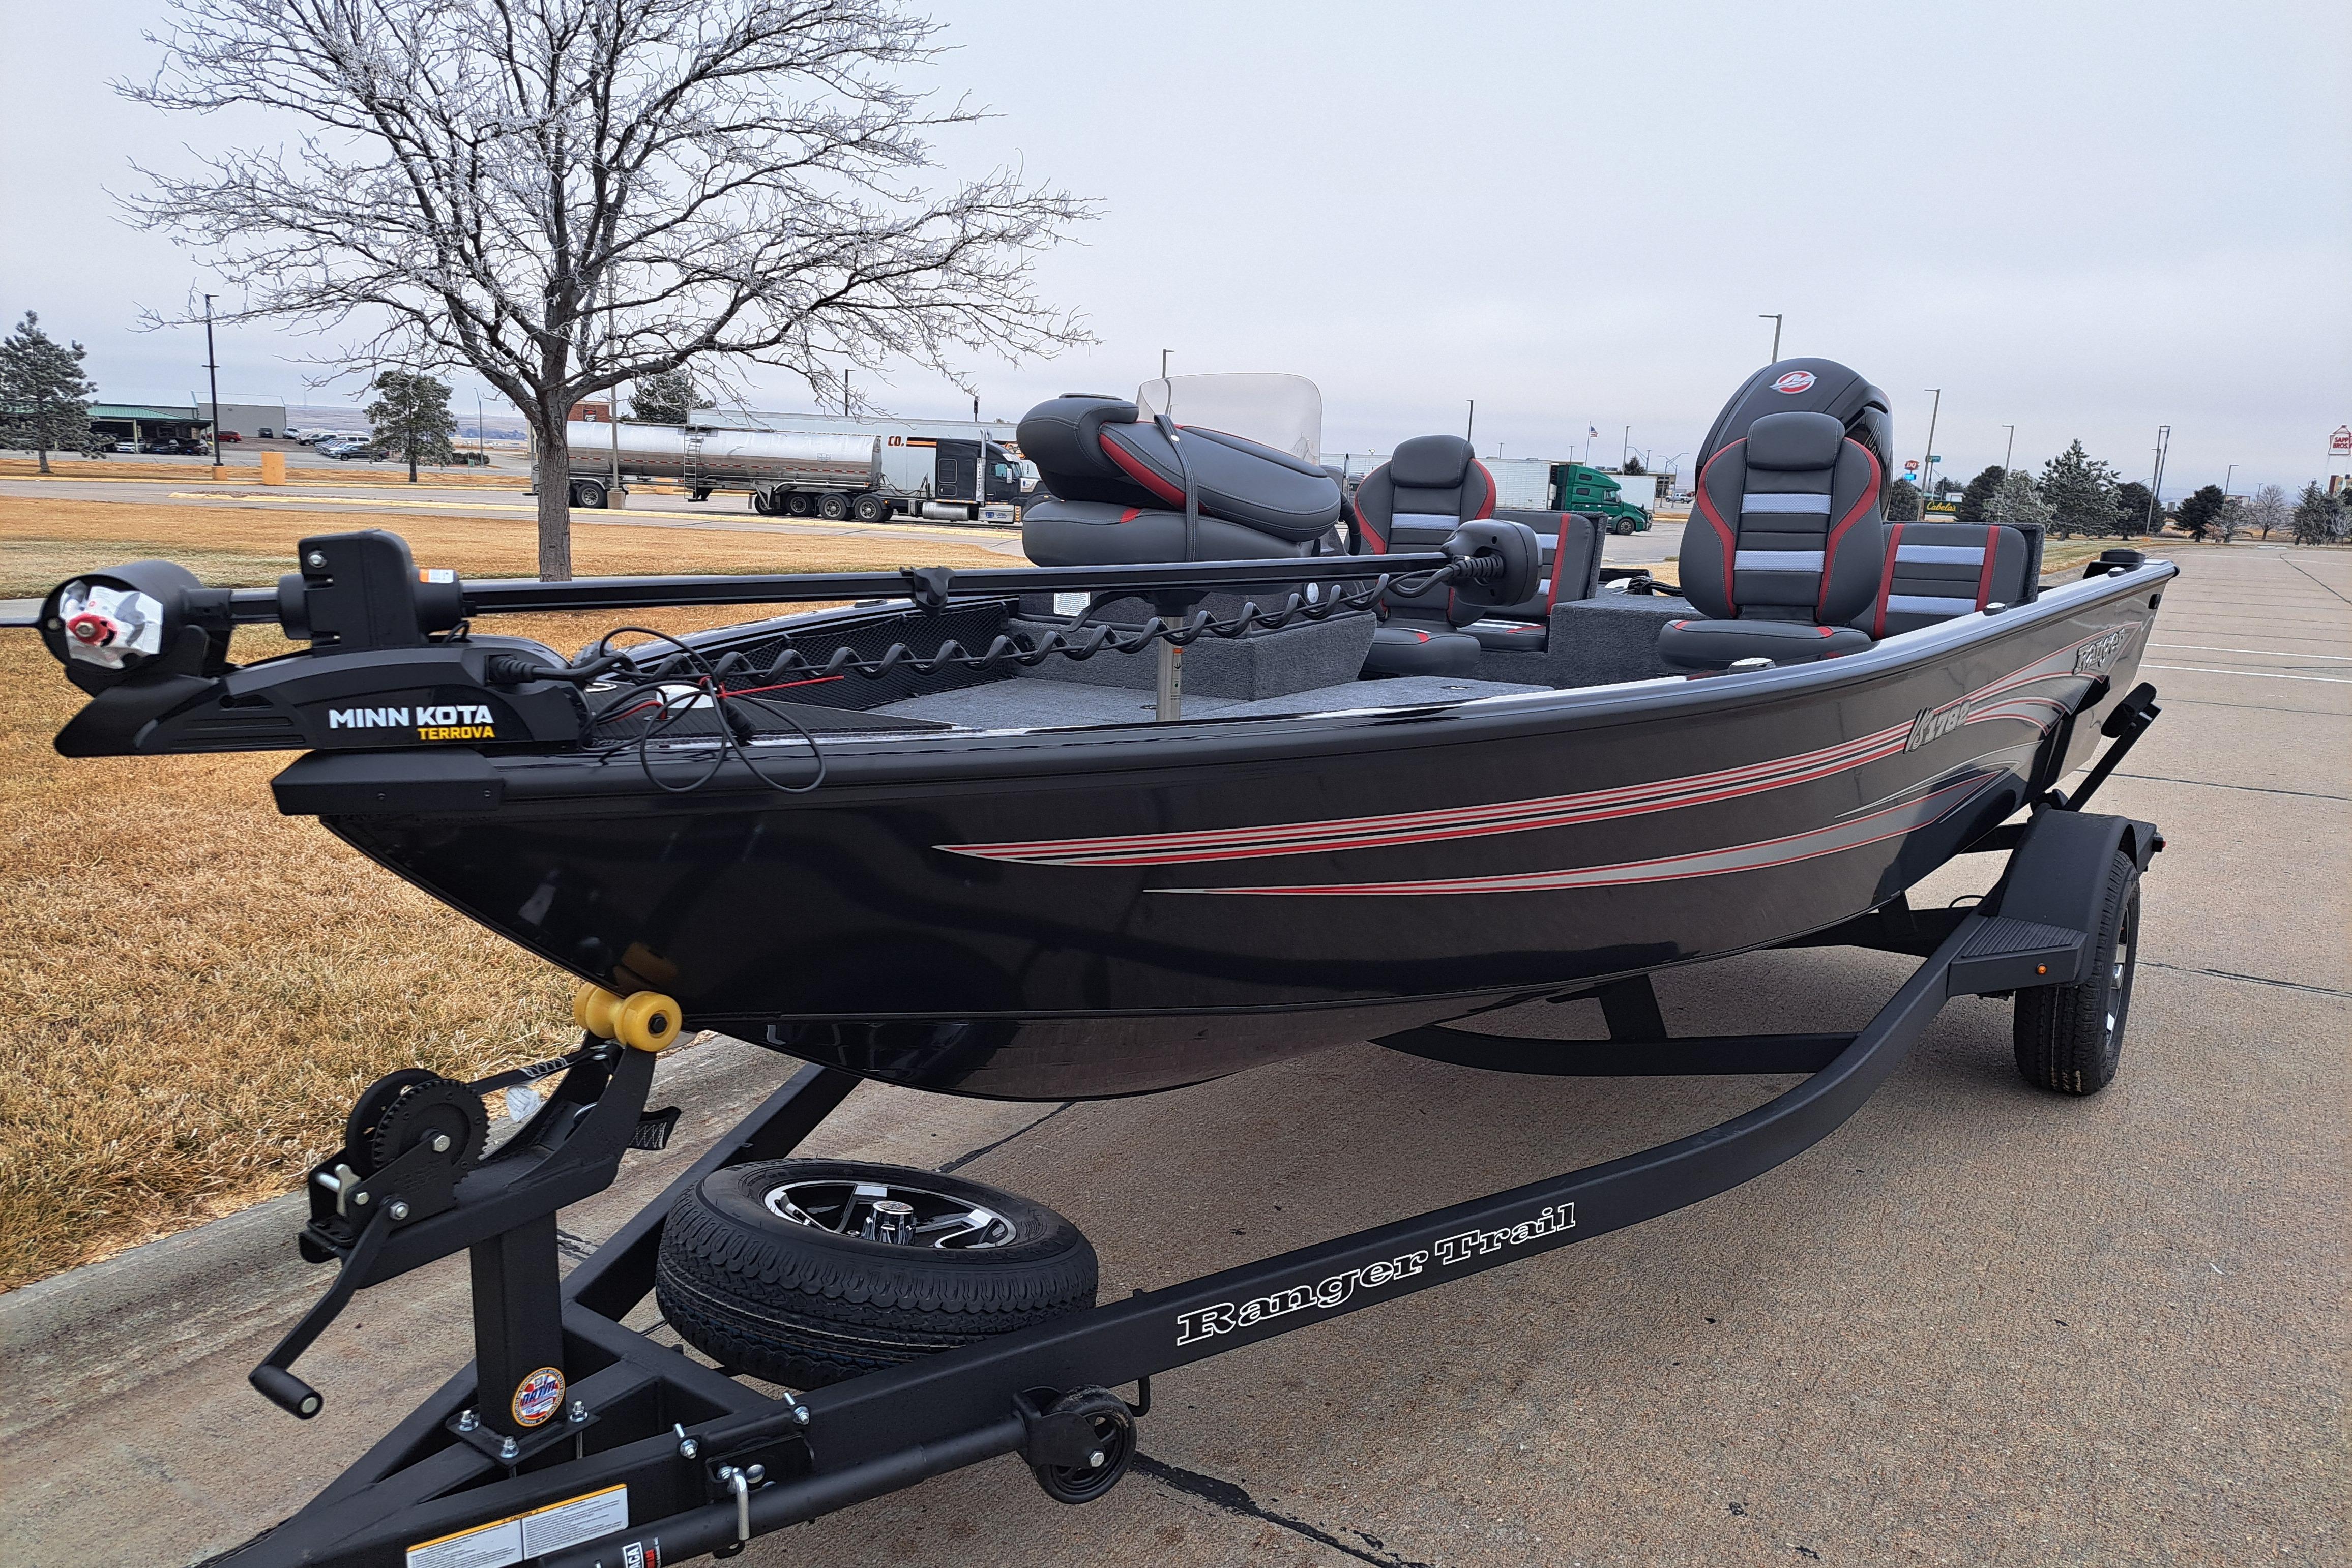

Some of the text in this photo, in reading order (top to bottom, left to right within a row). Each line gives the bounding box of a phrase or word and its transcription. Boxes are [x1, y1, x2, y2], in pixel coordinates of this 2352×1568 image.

[329, 705, 494, 729] MINN KOTA
[417, 726, 495, 740] TERROVA
[1177, 1202, 1576, 1346] Ranger Trail
